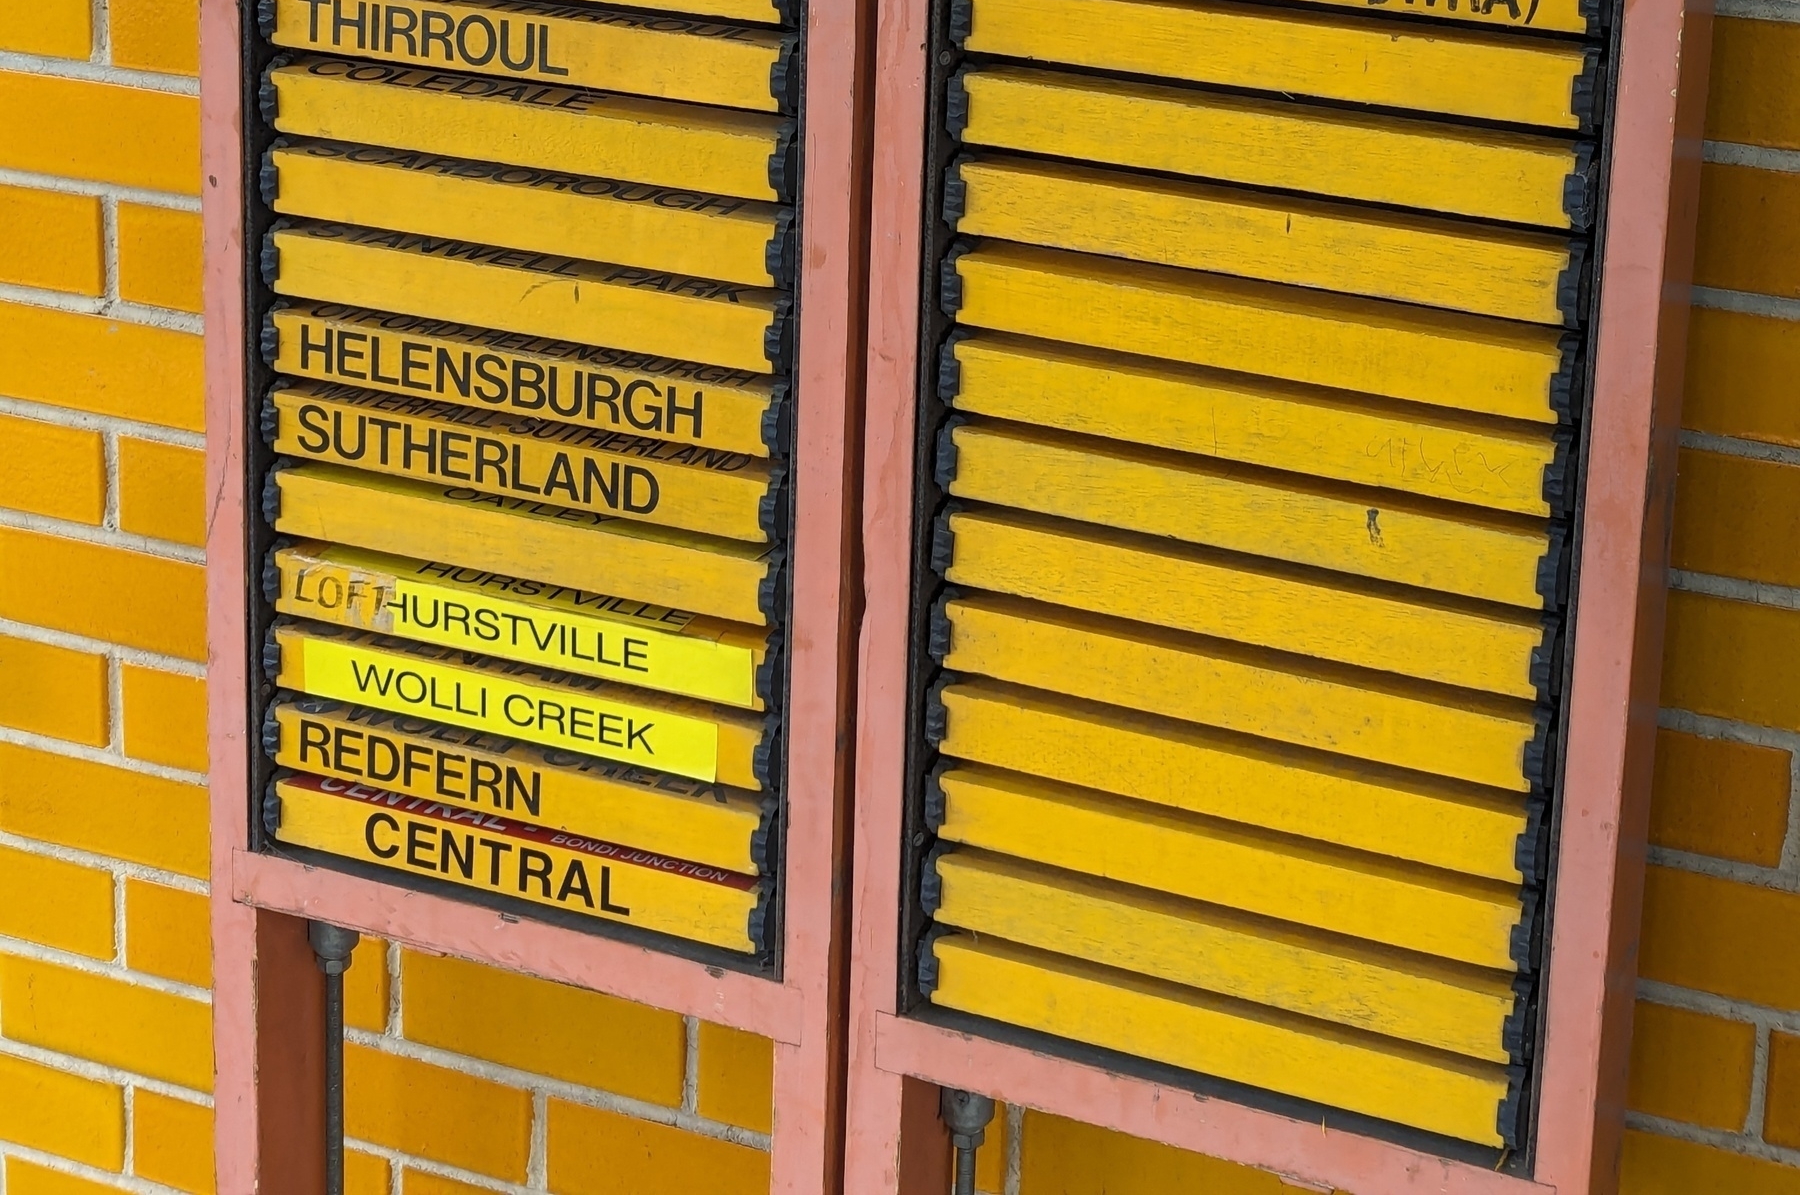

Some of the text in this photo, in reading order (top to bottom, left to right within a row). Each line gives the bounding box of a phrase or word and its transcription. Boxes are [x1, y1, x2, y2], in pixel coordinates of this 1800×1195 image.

[307, 61, 606, 111] COLEDALE
[307, 146, 747, 215] SCARBOROUGH
[307, 223, 743, 304] STANWELL PARK
[299, 324, 703, 439] HELENSBURGH
[297, 405, 660, 515] SUTHERLAND
[416, 561, 698, 626] HURSTVILLE
[351, 660, 656, 754] WOLLI CREEK
[299, 719, 541, 817] REDFERN
[365, 813, 630, 917] CENTRAL
[550, 834, 618, 858] BONDI
[619, 850, 728, 883] JUNCTION
